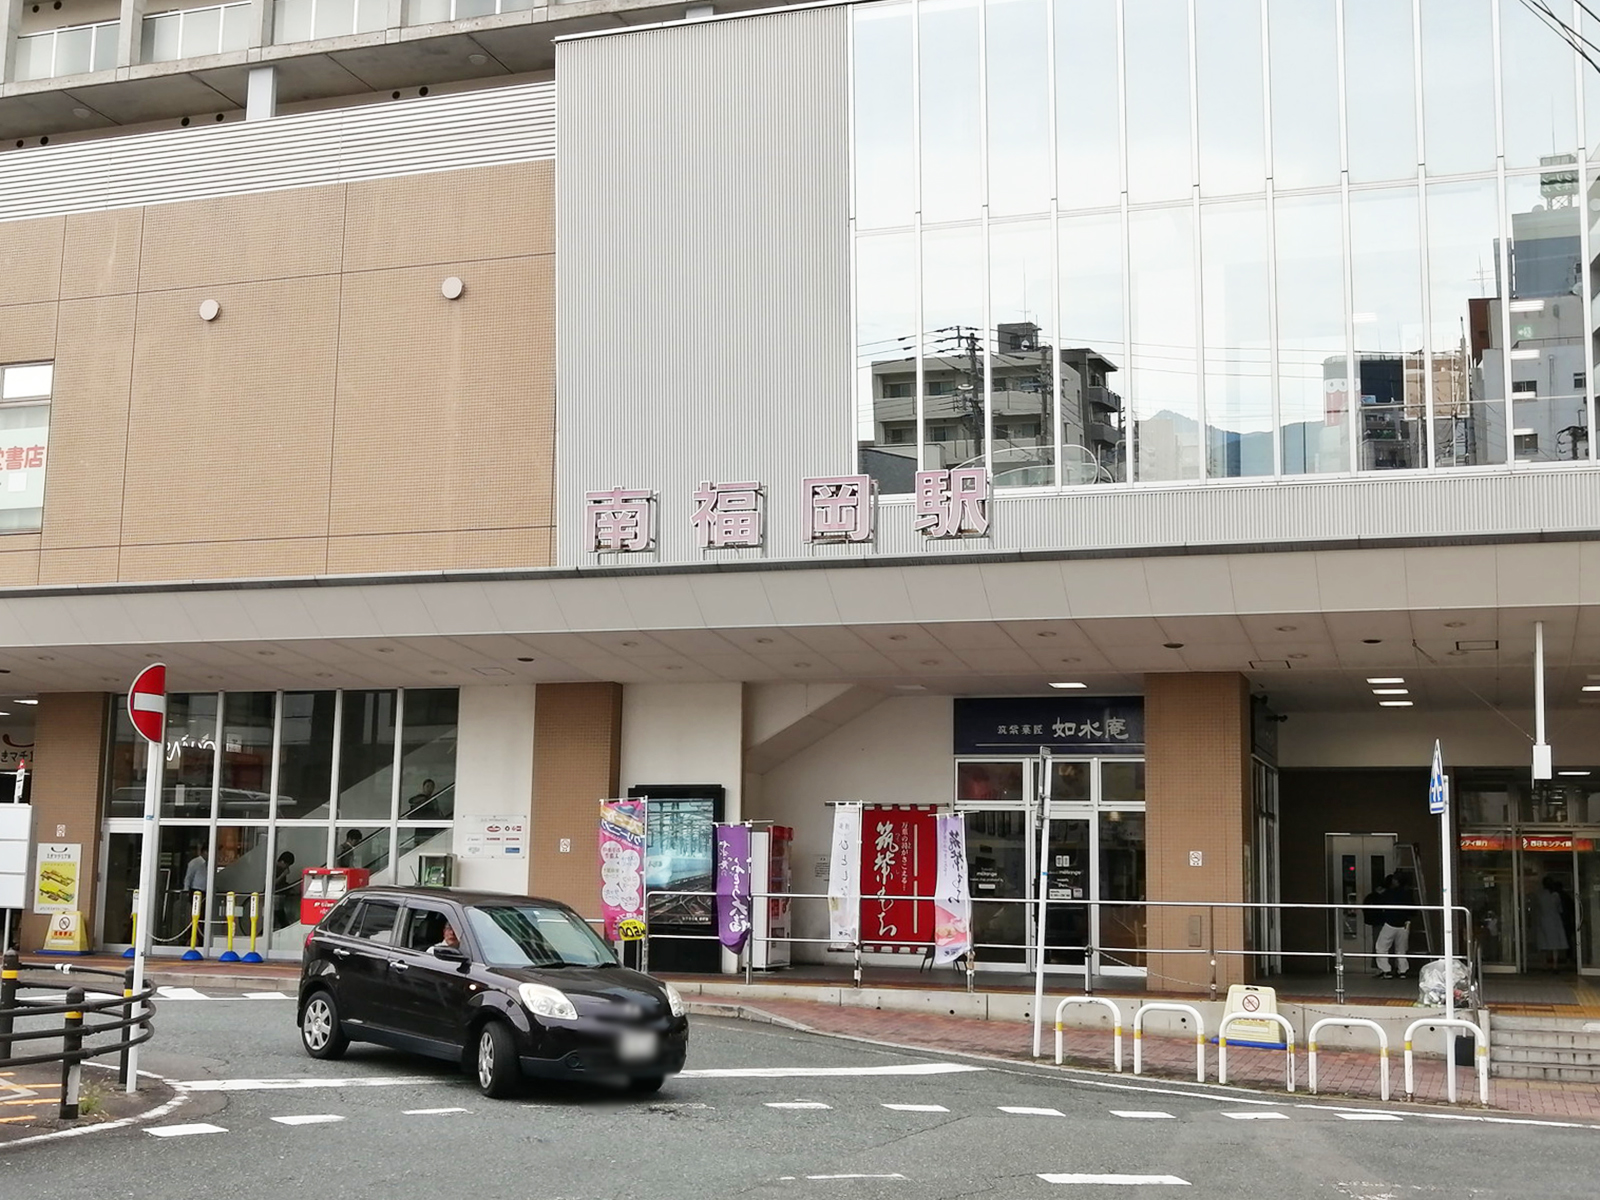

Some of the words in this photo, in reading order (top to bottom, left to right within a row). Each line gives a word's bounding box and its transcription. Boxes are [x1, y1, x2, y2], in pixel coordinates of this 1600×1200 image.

[0, 444, 45, 470] 書店
[584, 467, 990, 553] 南福岡駅
[1052, 717, 1129, 739] 如水庵
[873, 820, 899, 937] 筑紫もち
